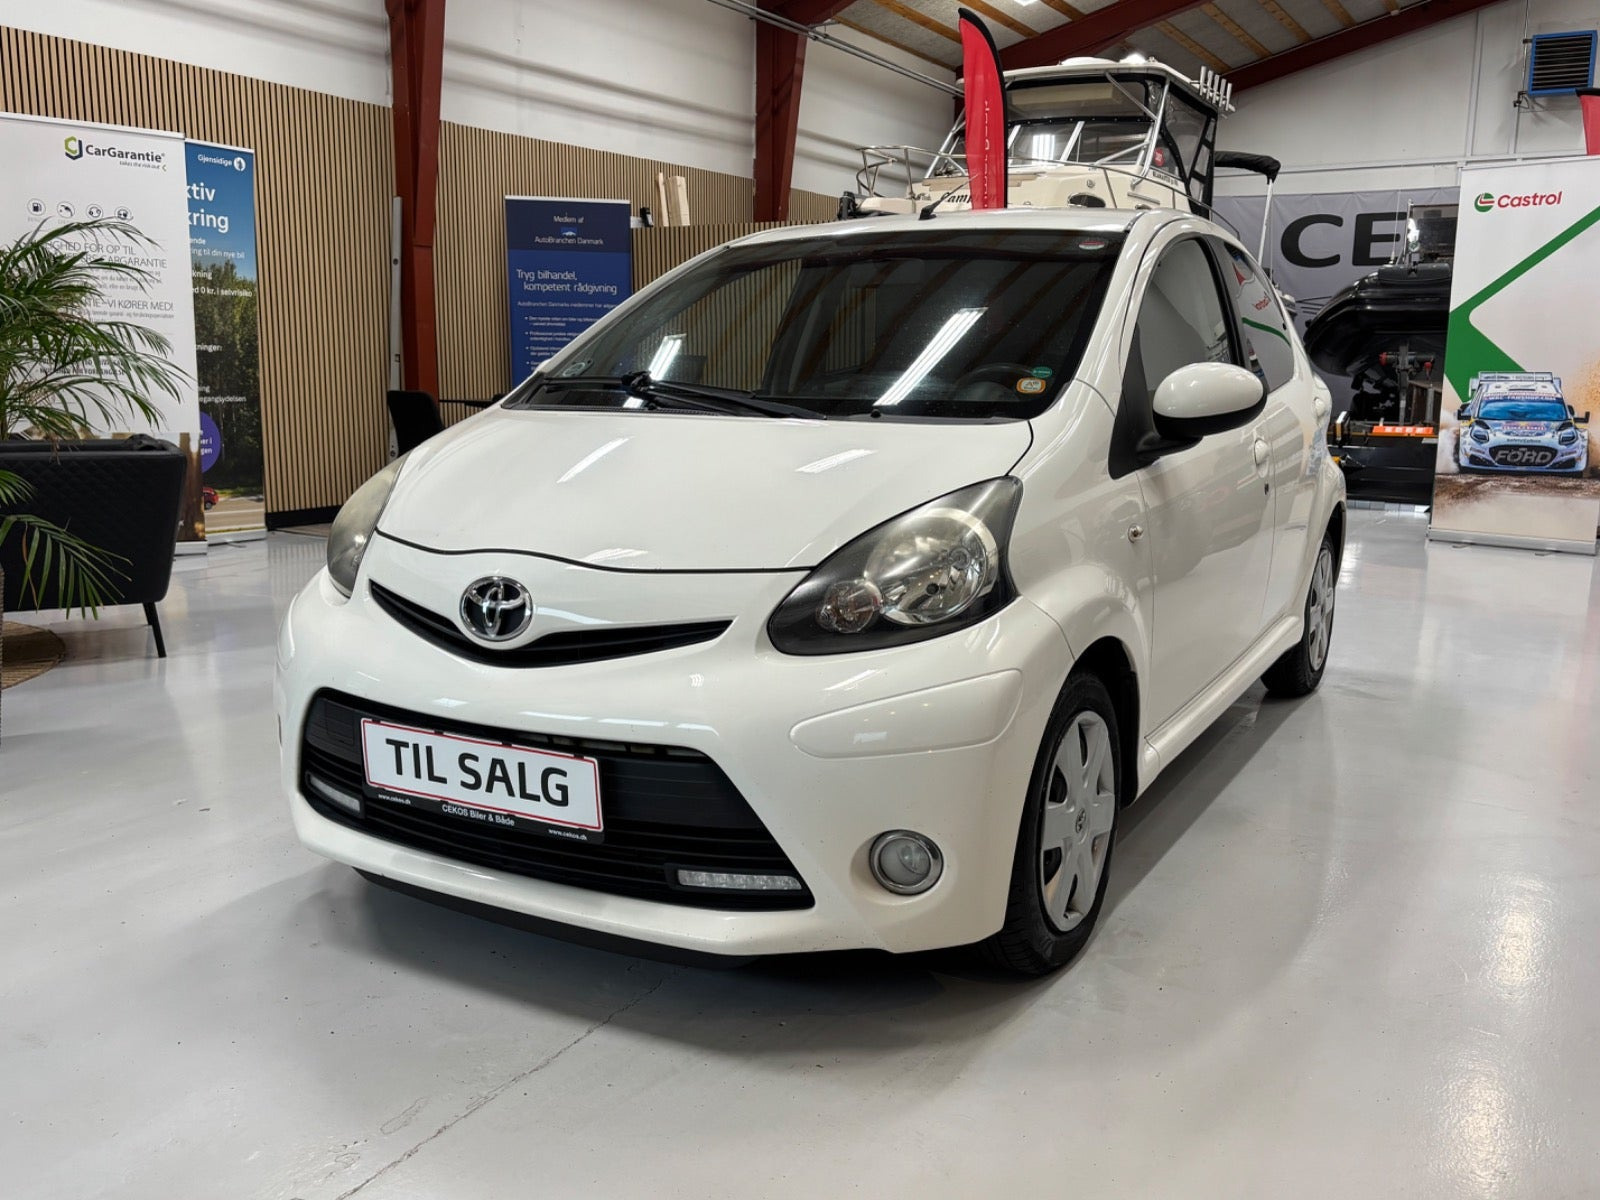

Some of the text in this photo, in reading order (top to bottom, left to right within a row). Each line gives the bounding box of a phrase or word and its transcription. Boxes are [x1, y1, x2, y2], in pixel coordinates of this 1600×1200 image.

[85, 144, 162, 163] CarGarantie
[198, 154, 232, 167] Gjensidige
[1497, 191, 1562, 209] Castrol
[553, 214, 585, 223] Medlem af
[534, 236, 576, 245] AutoBranchen
[122, 245, 136, 256] TIL
[516, 269, 578, 282] Tryg bilhandel,
[524, 282, 617, 296] kompetent rådgivning
[1496, 449, 1552, 464] FORD
[386, 738, 569, 808] TIL SALG
[378, 793, 412, 805] www.cekos.dk
[442, 804, 515, 826] CEKOS Biler & Både
[548, 828, 588, 841] www.cekos.dk
